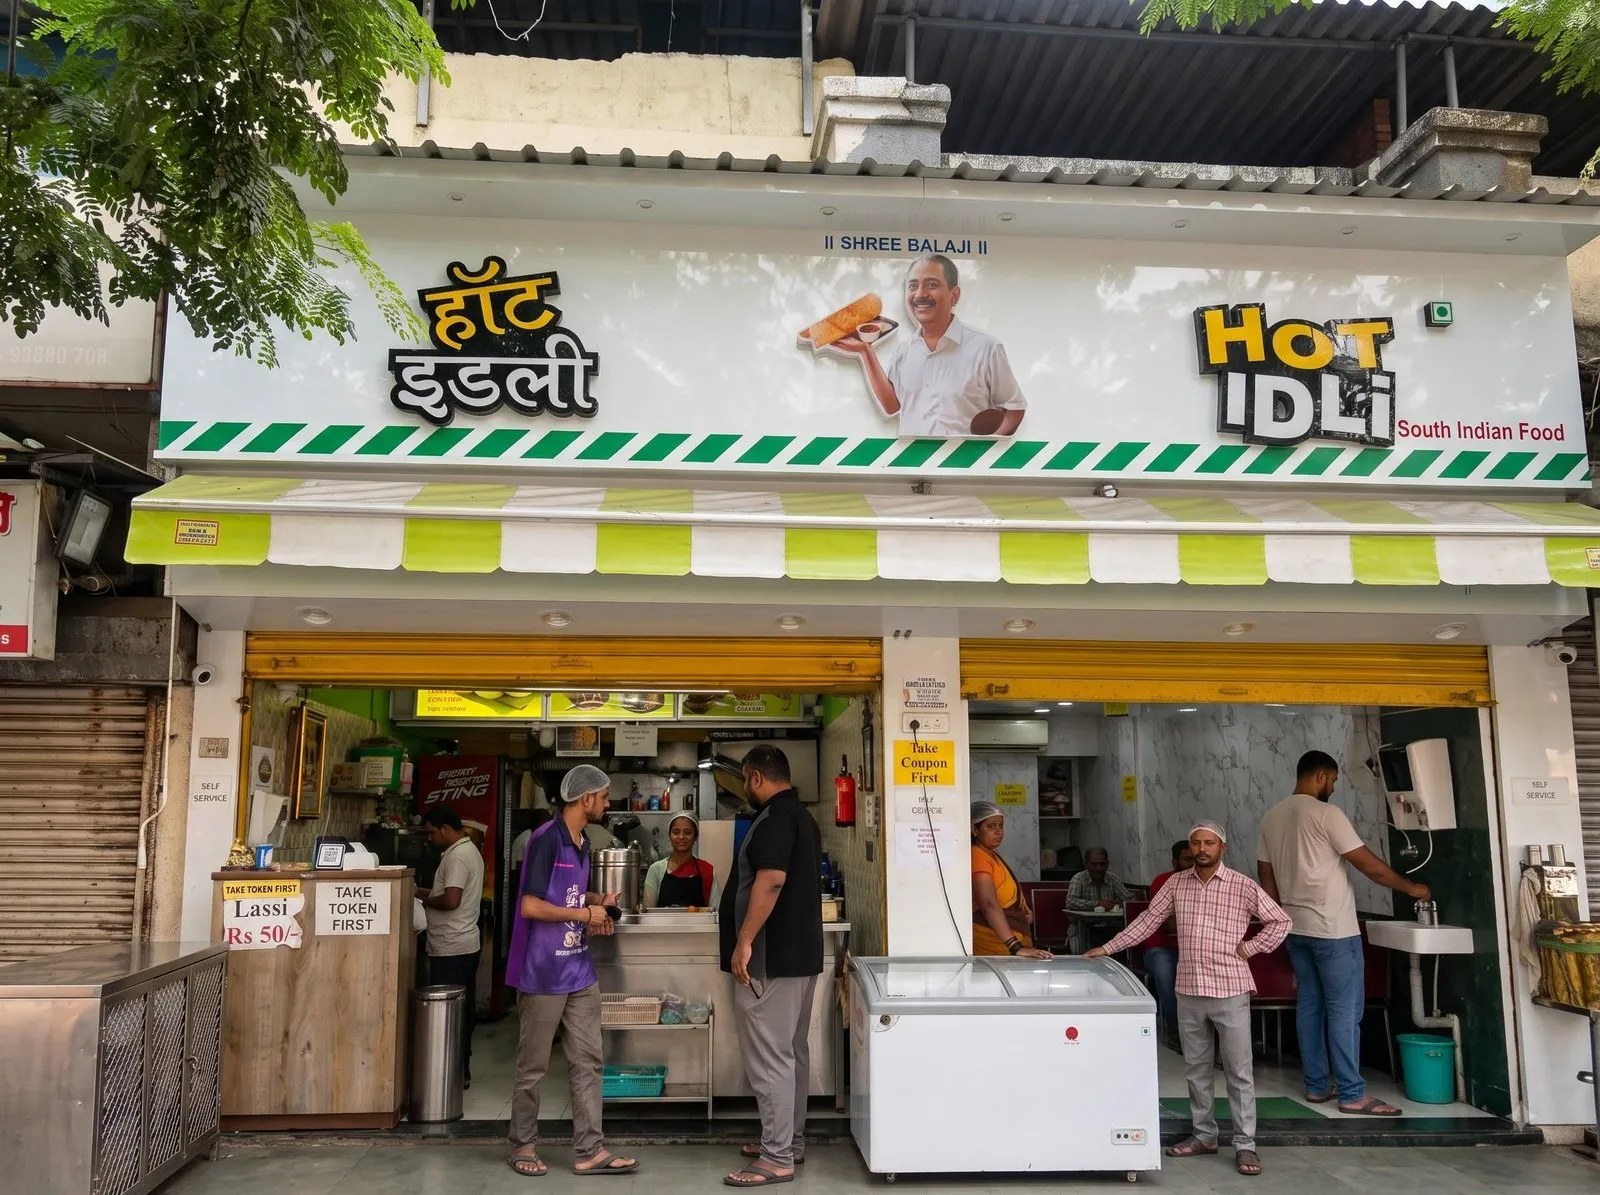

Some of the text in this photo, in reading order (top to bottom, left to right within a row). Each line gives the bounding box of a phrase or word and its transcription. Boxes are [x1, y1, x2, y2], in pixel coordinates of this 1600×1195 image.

[840, 235, 902, 252] SHREE
[908, 237, 972, 254] BALAJI
[1204, 306, 1390, 370] HOT
[393, 332, 598, 418] इडली
[1397, 419, 1566, 442] South Indian Food
[910, 742, 938, 754] Take
[901, 756, 947, 771] Coupon
[911, 772, 938, 783] First
[201, 782, 221, 790] SELF
[193, 794, 227, 802] SERVICE
[424, 783, 490, 804] STING
[226, 884, 297, 894] TAKE TOKEN FIRST
[335, 886, 372, 898] TAKE
[234, 898, 288, 918] Lassi
[329, 903, 377, 914] TOKEN
[333, 919, 373, 931] FIRST
[227, 924, 299, 945] Rs 50/-
